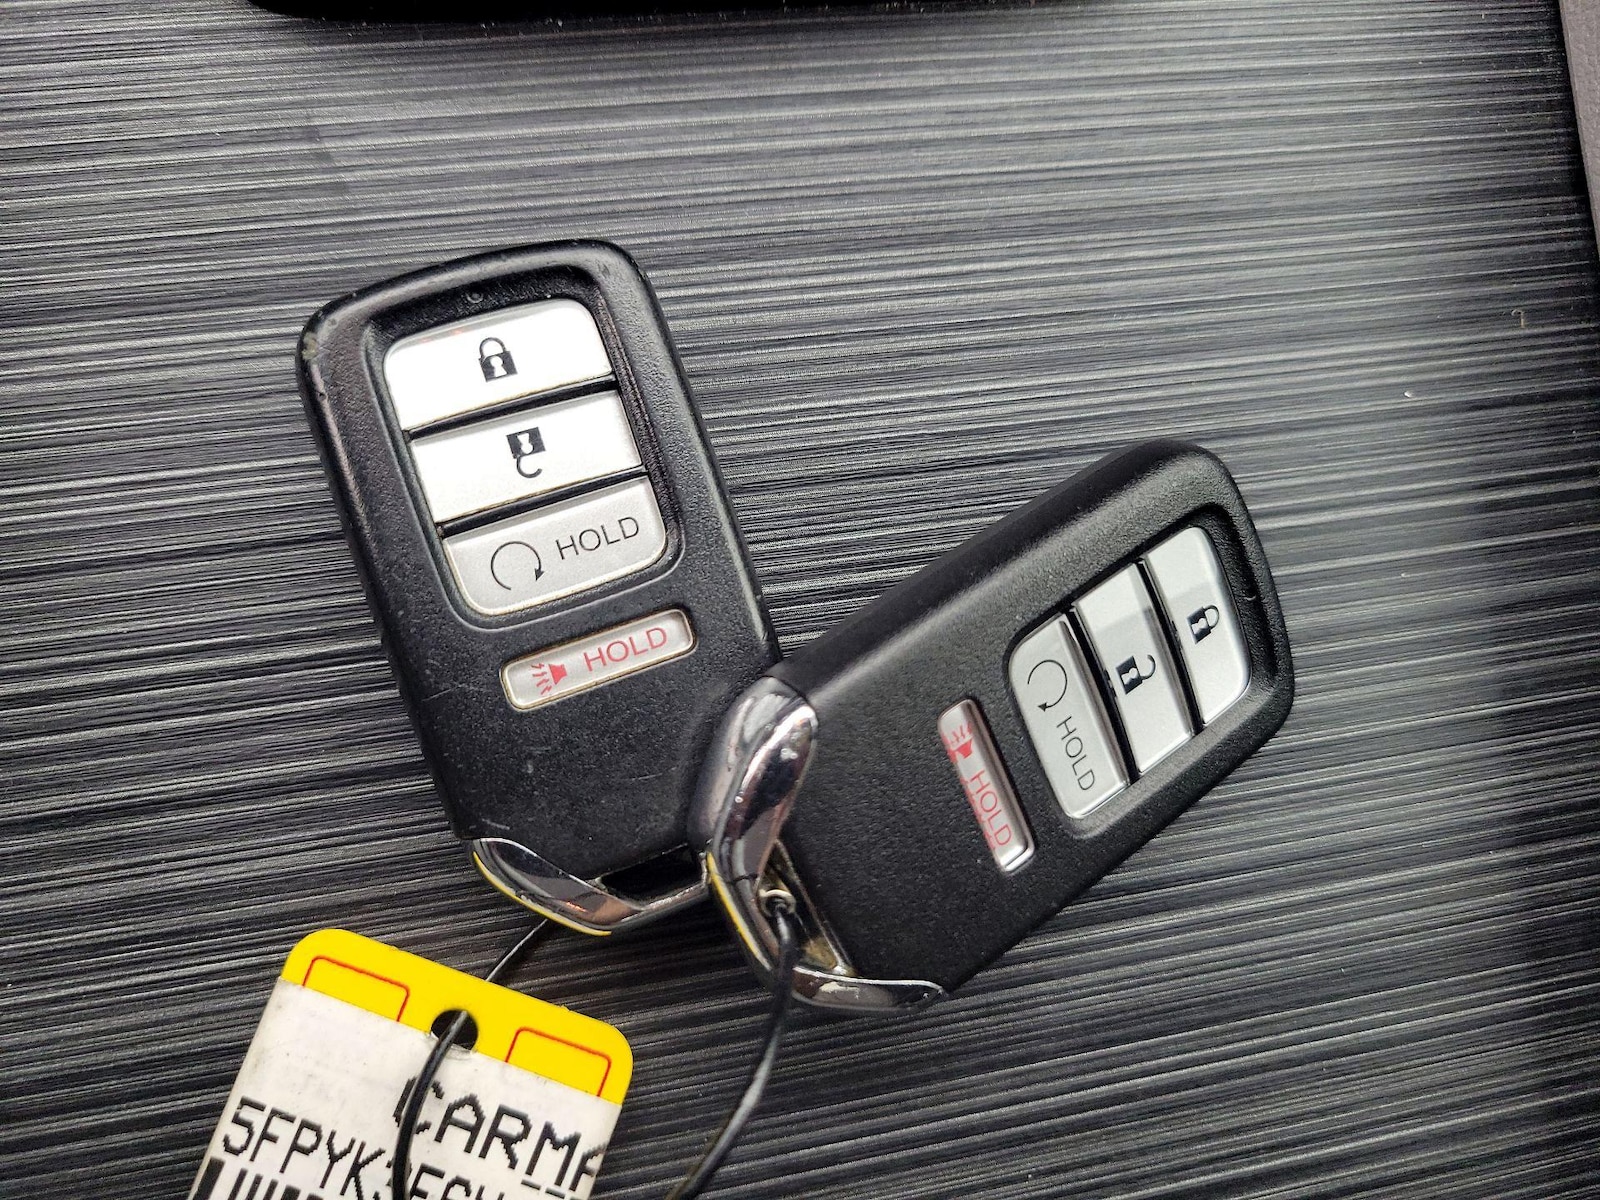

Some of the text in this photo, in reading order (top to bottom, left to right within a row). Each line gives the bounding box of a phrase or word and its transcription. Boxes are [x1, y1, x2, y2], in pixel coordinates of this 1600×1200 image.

[555, 516, 639, 560] HOLD
[583, 627, 668, 672] HOLD
[1056, 715, 1096, 791] HOLD
[970, 769, 1013, 846] HOLD
